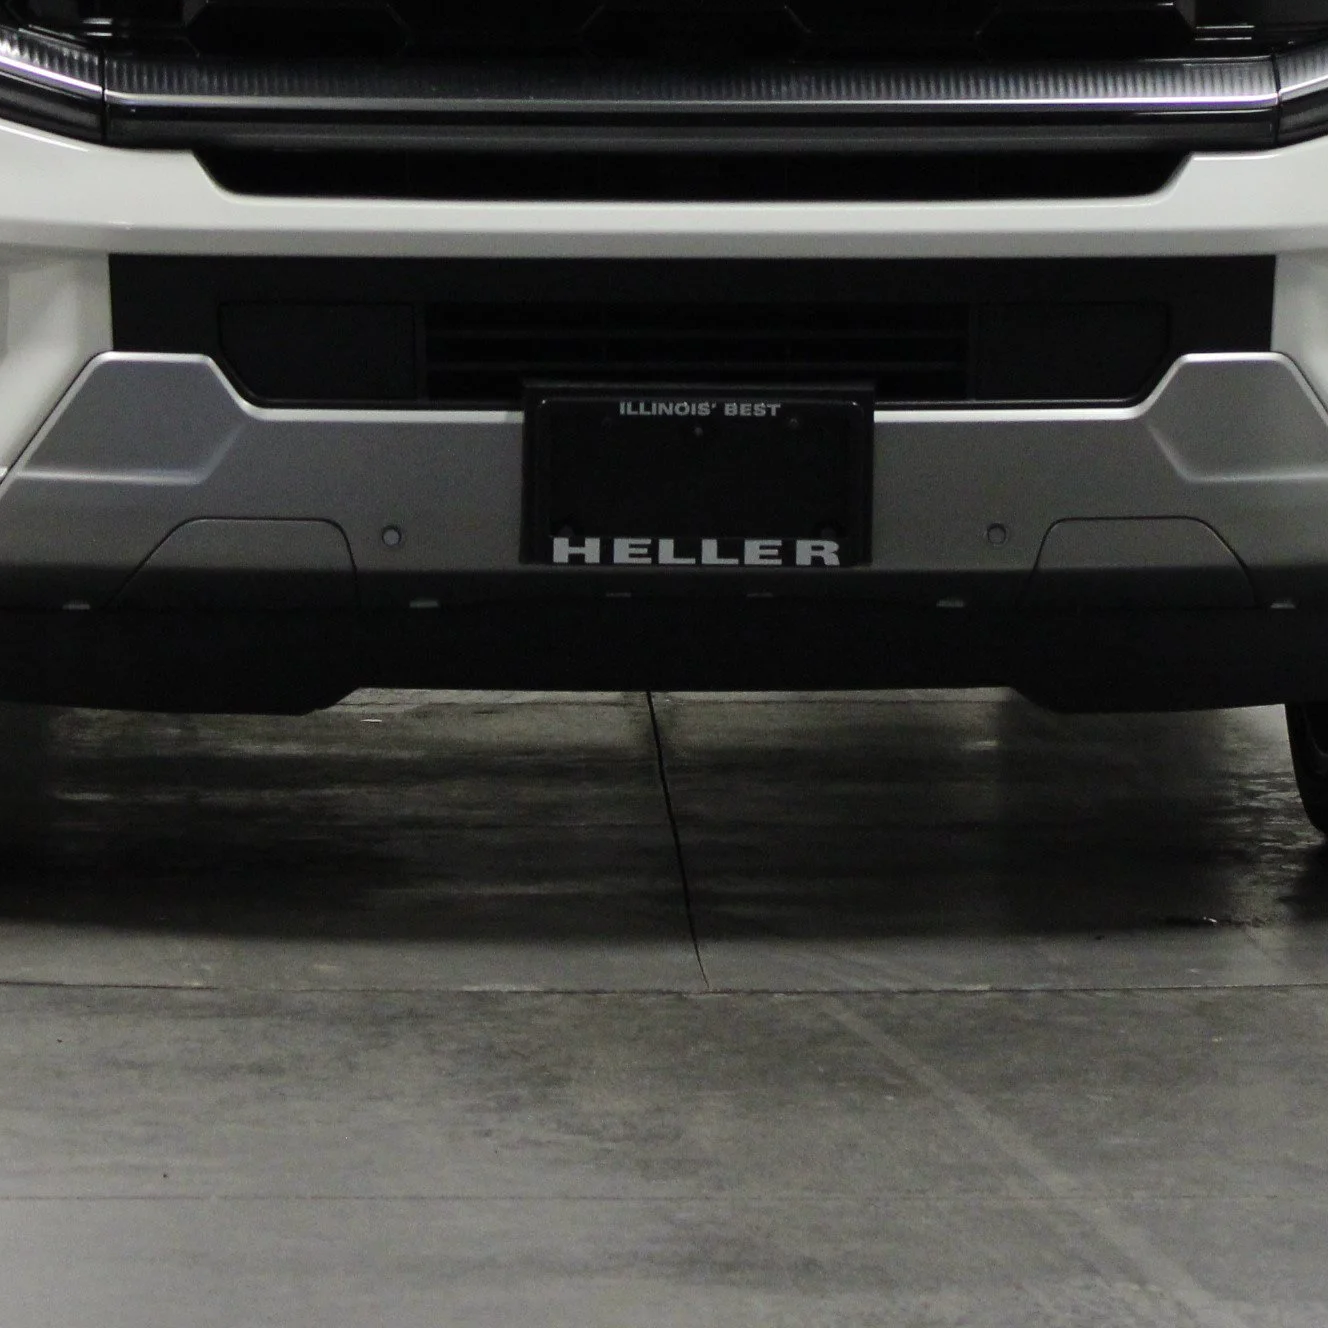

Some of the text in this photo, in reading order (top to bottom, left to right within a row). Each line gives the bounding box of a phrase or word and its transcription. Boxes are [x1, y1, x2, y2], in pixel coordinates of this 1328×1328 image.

[619, 401, 781, 417] ILLINOIS' BEST
[552, 536, 841, 566] HELLER
